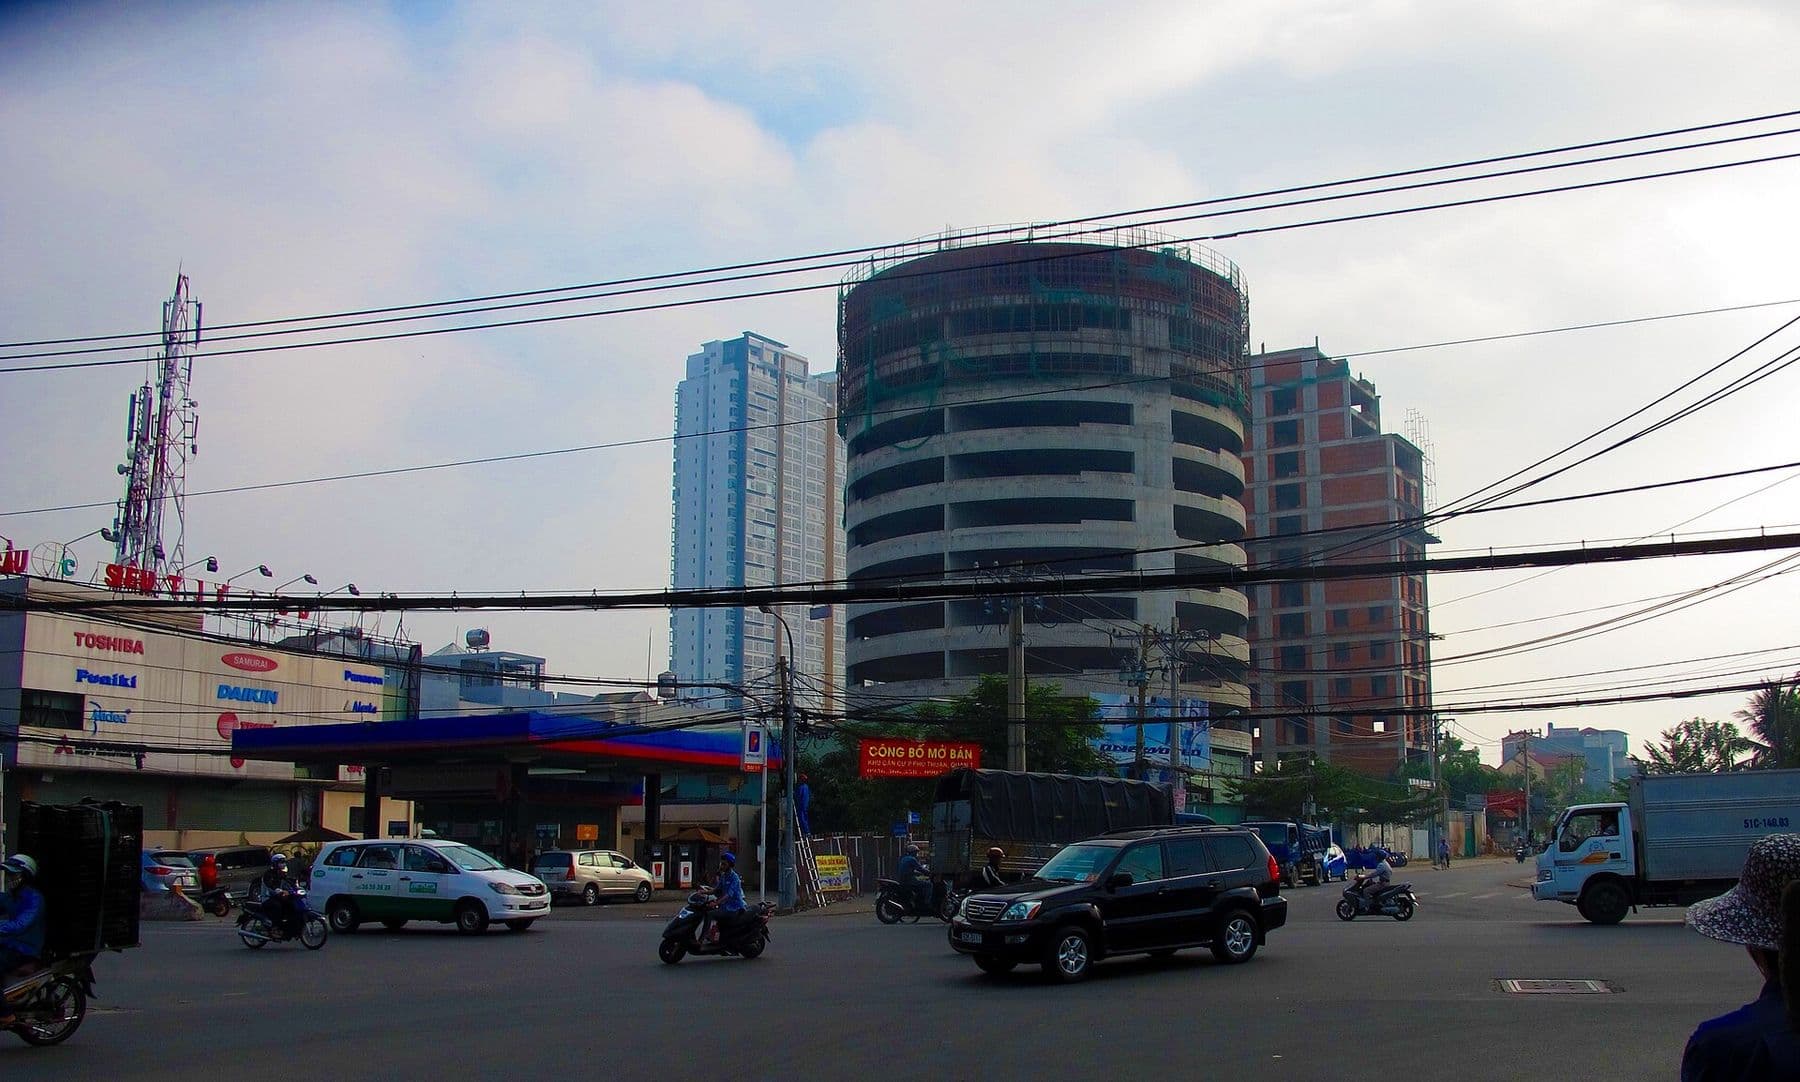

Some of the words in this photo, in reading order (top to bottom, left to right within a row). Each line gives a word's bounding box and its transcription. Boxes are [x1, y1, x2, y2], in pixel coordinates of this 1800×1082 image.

[74, 632, 145, 655] TOSHIBA
[233, 655, 268, 669] SAMURAI
[217, 684, 279, 705] DAIKIN
[868, 744, 905, 758] CÔNG
[908, 744, 925, 759] BỐ
[928, 744, 947, 760] MỞ
[949, 745, 973, 760] BÁN
